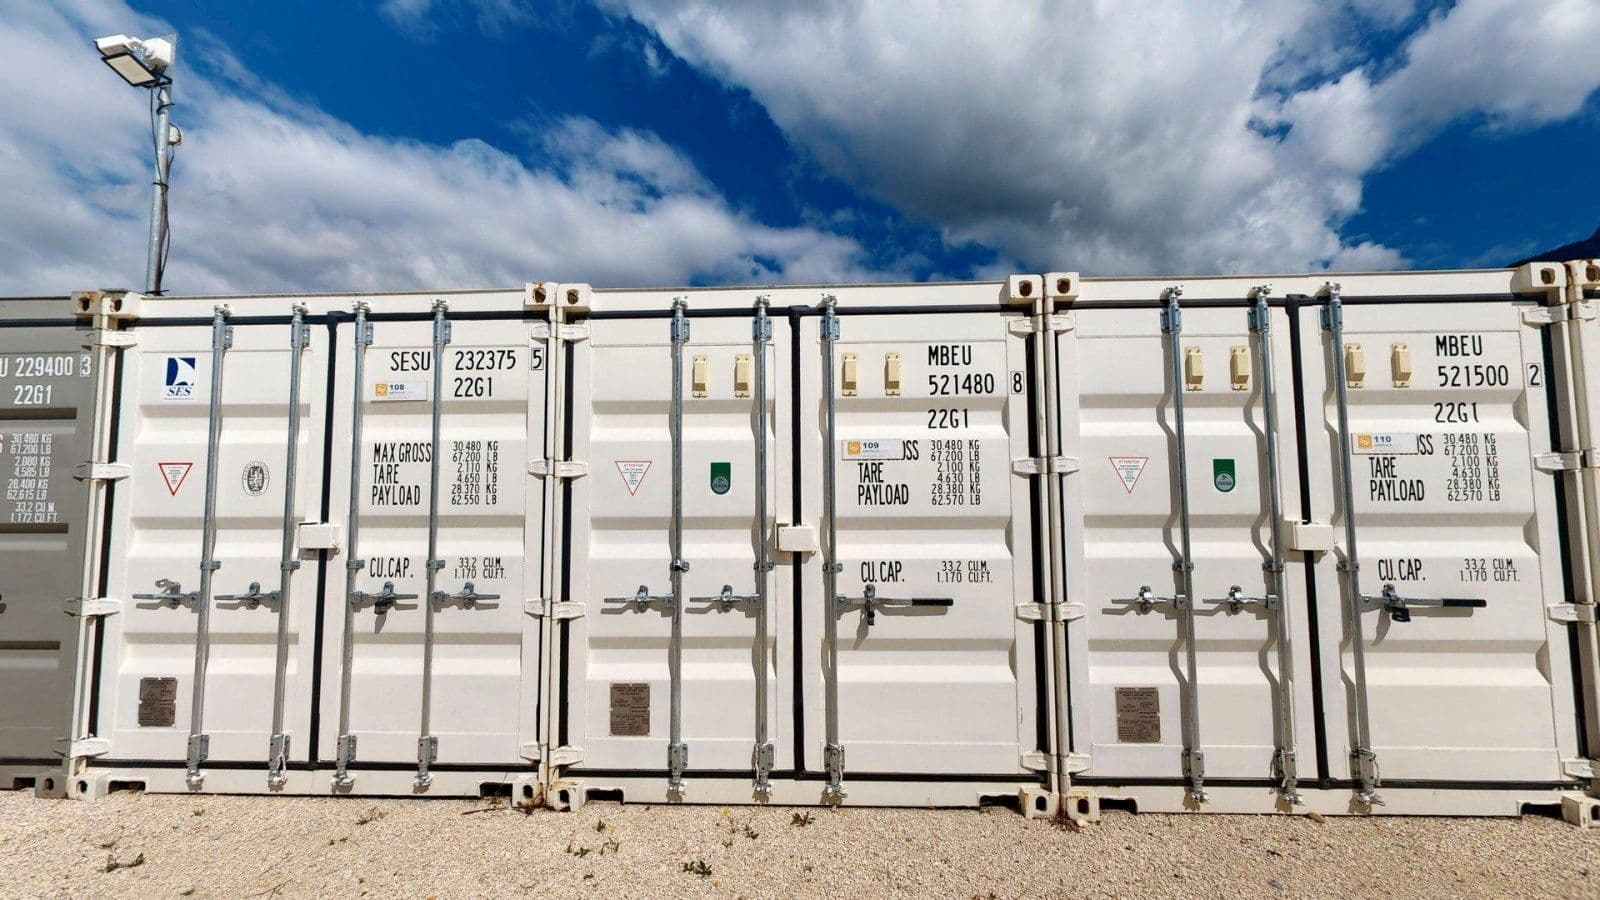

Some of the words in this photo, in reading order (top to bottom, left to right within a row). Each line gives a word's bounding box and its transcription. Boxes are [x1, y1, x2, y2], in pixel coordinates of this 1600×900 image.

[1436, 335, 1483, 357] MBEU
[390, 351, 431, 371] SESU
[455, 350, 516, 370] 232375
[533, 350, 542, 369] 5
[928, 345, 971, 366] MBEU
[15, 356, 73, 377] 229400
[82, 356, 91, 375] 3
[1438, 365, 1509, 387] 521500
[1529, 364, 1541, 386] 2
[454, 377, 492, 397] 22G1
[929, 373, 994, 395] 521480
[1013, 372, 1023, 393] 8
[14, 384, 52, 405] 22G1
[167, 386, 192, 397] SES
[927, 408, 969, 429] 22G1
[1434, 402, 1479, 423] 22G1
[41, 433, 52, 444] KG
[1374, 435, 1392, 443] 110
[1443, 433, 1478, 445] 30.480
[1484, 433, 1496, 444] KG
[40, 443, 52, 455] LB
[453, 441, 481, 452] 30.480
[487, 441, 499, 451] KG
[930, 439, 963, 451] 30.480
[968, 439, 980, 450] KG
[1444, 444, 1479, 456] 67.200
[1485, 444, 1497, 456] LB
[373, 442, 396, 463] MAX
[399, 442, 432, 463] GROSS
[452, 452, 481, 463] 67.200
[486, 452, 498, 462] LB
[930, 451, 963, 462] 67.200
[969, 451, 980, 462] LB
[373, 464, 399, 484] TARE
[457, 463, 481, 473] 2.110
[486, 463, 498, 473] KG
[858, 462, 884, 483] TARE
[937, 462, 963, 472] 2.100
[969, 462, 981, 473] KG
[1369, 456, 1398, 479] TARE
[1452, 456, 1480, 467] 2.100
[1486, 456, 1499, 467] KG
[1452, 467, 1481, 479] 4.630
[1487, 467, 1499, 478] LB
[486, 473, 498, 483] LB
[937, 473, 964, 483] 4.630
[969, 473, 981, 483] LB
[371, 485, 421, 506] PAYLOAD
[451, 484, 480, 495] 28.370
[485, 484, 497, 495] KG
[858, 484, 909, 505] PAYLOAD
[931, 484, 964, 495] 28.380
[969, 484, 981, 495] KG
[1370, 479, 1425, 502] PAYLOAD
[1446, 479, 1482, 490] 28.380
[1488, 479, 1500, 490] KG
[1447, 490, 1483, 502] 62.570
[1489, 490, 1501, 501] LB
[451, 495, 480, 505] 62.550
[485, 495, 497, 505] LB
[931, 495, 964, 505] 62.570
[970, 495, 981, 505] LB
[458, 557, 477, 568] 33.2
[941, 560, 962, 572] 33.2
[1464, 558, 1486, 570] 33.2
[454, 568, 477, 579] 1.170
[936, 571, 962, 583] 1.170
[1459, 570, 1487, 582] 1.170
